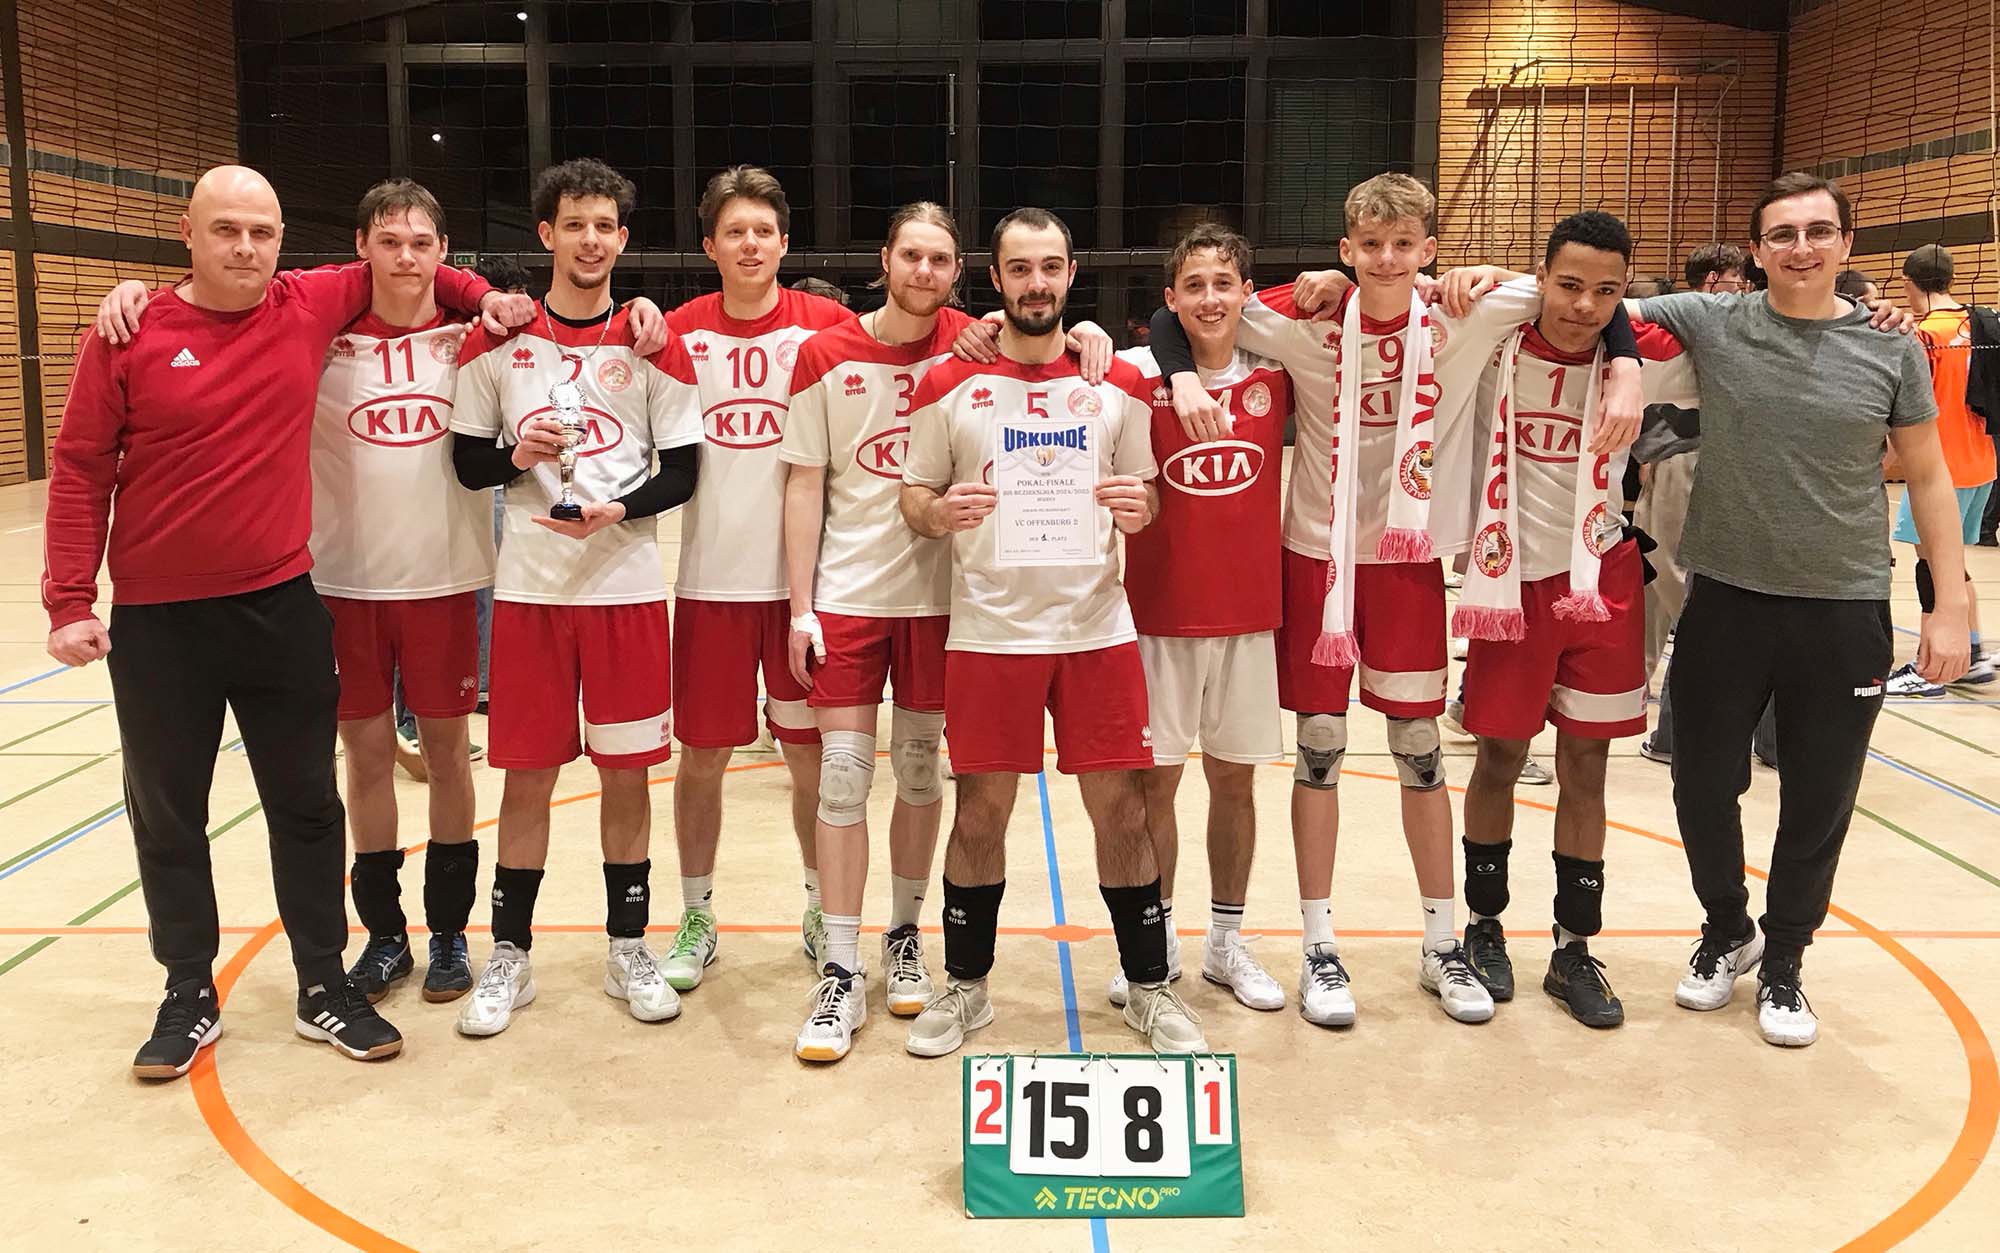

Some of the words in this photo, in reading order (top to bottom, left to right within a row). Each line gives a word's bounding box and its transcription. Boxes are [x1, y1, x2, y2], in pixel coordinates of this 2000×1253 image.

[374, 338, 414, 384] 11
[726, 346, 768, 388] 10
[1378, 336, 1404, 378] 9
[894, 374, 915, 417] 3
[1548, 367, 1566, 408] 1
[1027, 392, 1049, 418] 5
[1361, 391, 1393, 416] KI
[365, 405, 442, 436] KIA
[714, 410, 782, 437] KIA
[1003, 425, 1087, 452] URKUNDE
[1515, 421, 1581, 453] KIA
[1181, 452, 1253, 485] KIA
[1026, 518, 1071, 527] OFFENBURG
[1854, 685, 1882, 697] PUMA
[975, 1080, 1002, 1134] 2
[1022, 1080, 1090, 1160] 15
[1123, 1085, 1164, 1163] 8
[1203, 1081, 1221, 1135] 1
[1064, 1186, 1160, 1210] TECNO
[1160, 1187, 1181, 1196] PRO
